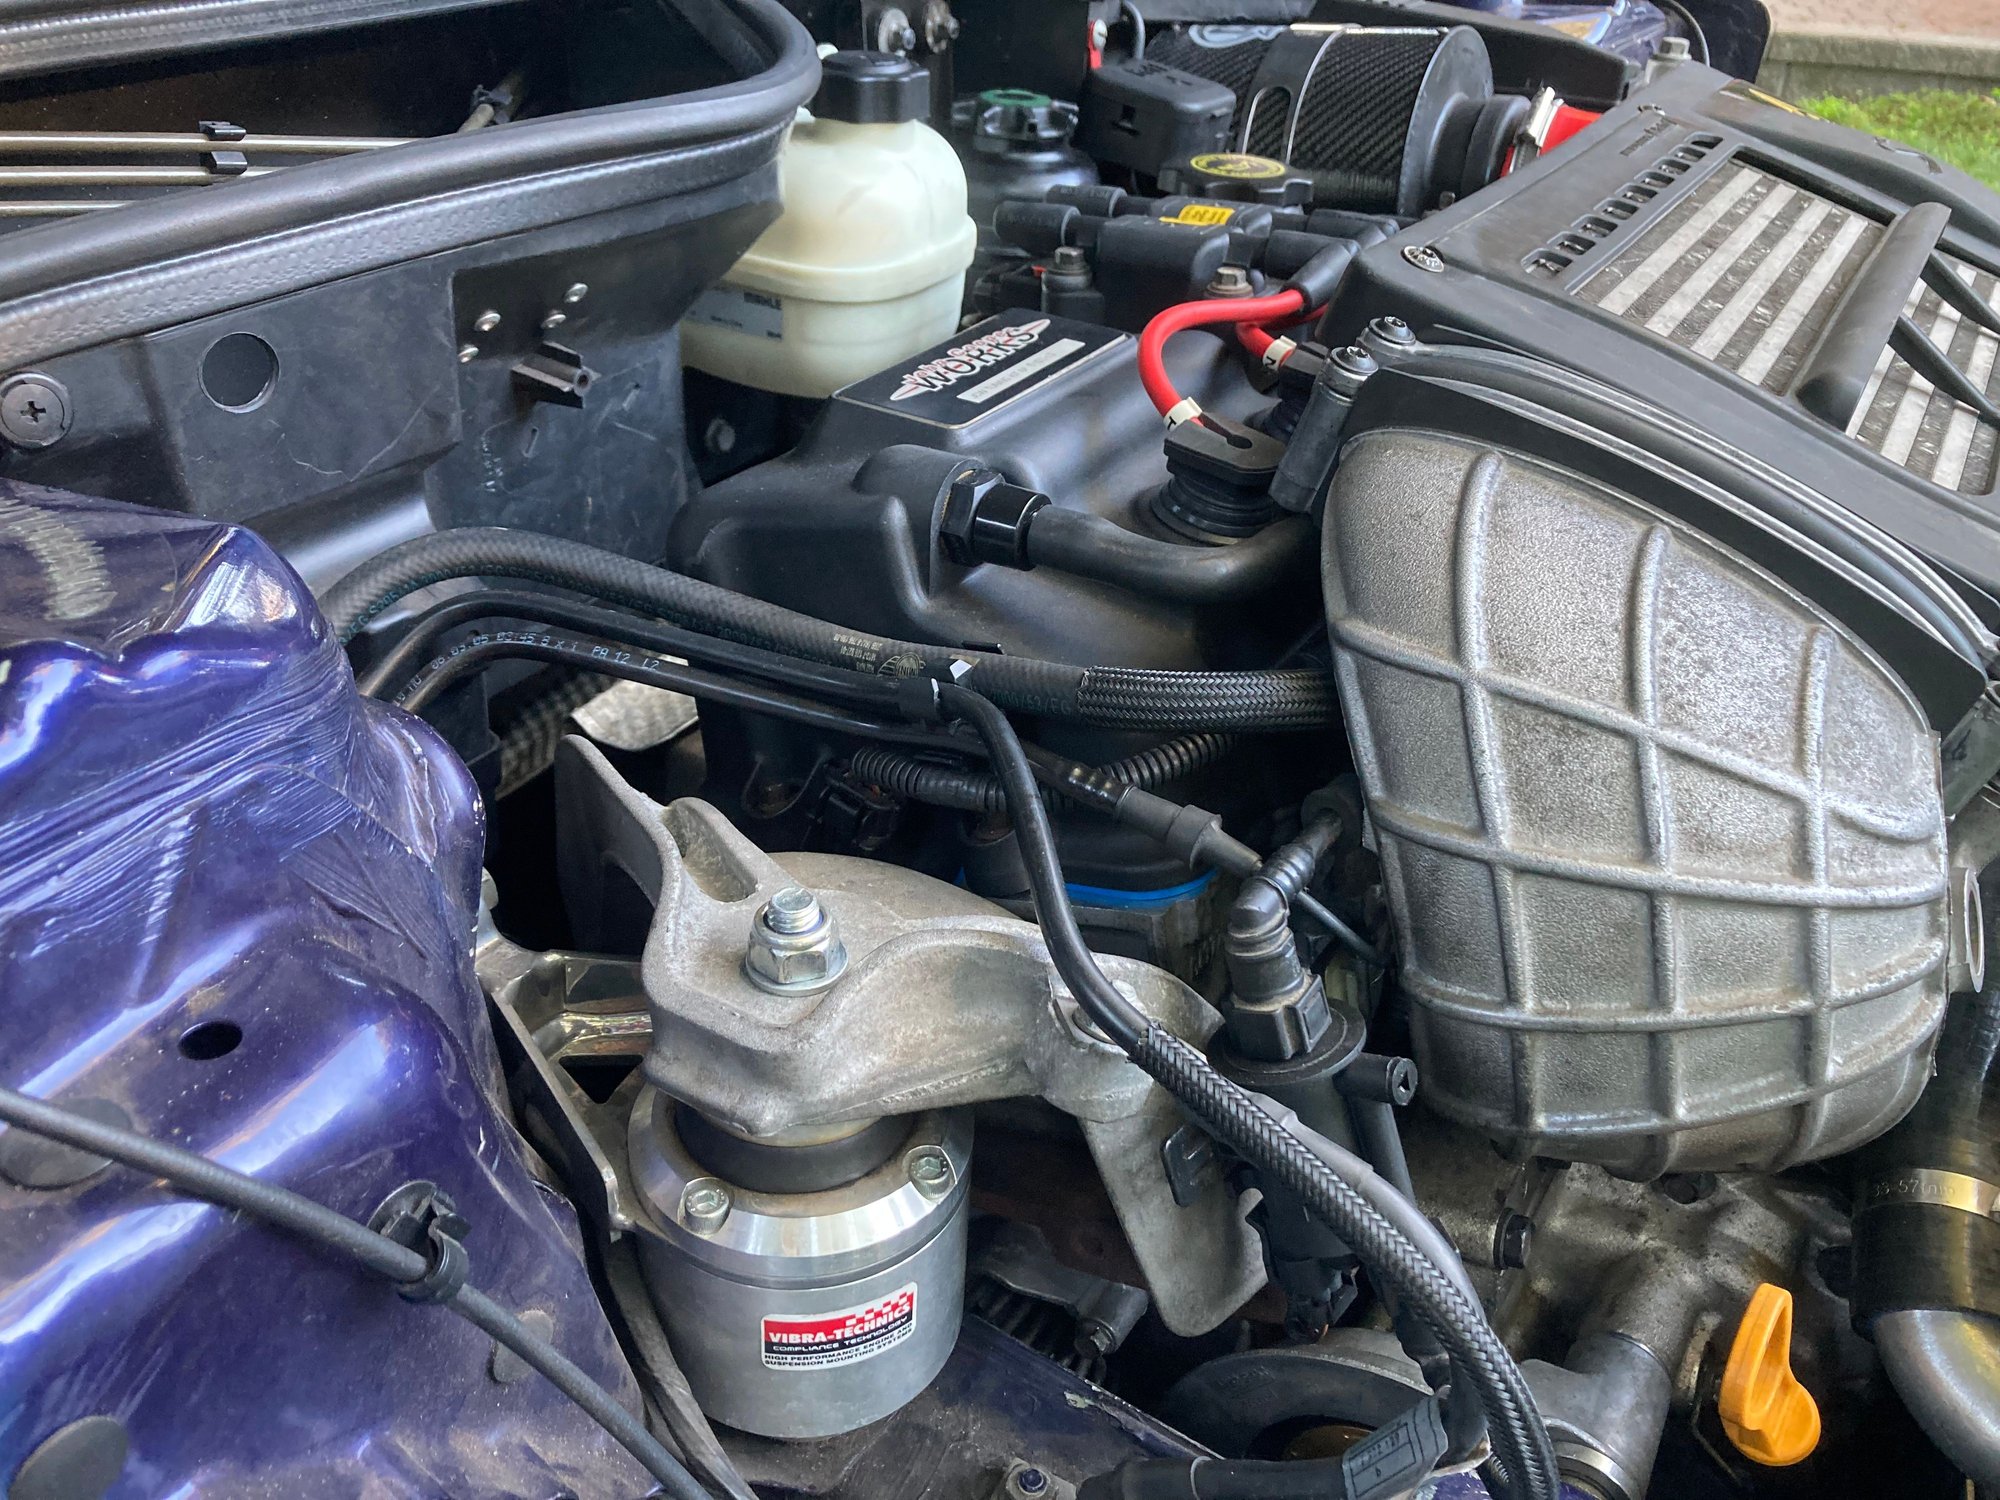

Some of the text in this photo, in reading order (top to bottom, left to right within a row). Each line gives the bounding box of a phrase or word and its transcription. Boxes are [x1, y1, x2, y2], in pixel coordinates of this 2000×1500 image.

[904, 358, 948, 384] John
[950, 328, 1014, 357] Cooper
[913, 329, 1035, 389] WORKS
[591, 645, 609, 658] PA
[614, 651, 631, 665] 12
[769, 1301, 911, 1343] VIBRA-TECHNICS
[773, 1316, 907, 1352] COMPLIANCE TECHNOLOGY
[791, 1347, 860, 1361] PERFORMANCE
[863, 1334, 894, 1349] ENGINE
[897, 1322, 912, 1335] AND
[826, 1348, 874, 1363] MOUNTING
[877, 1328, 912, 1349] SYSTEMS
